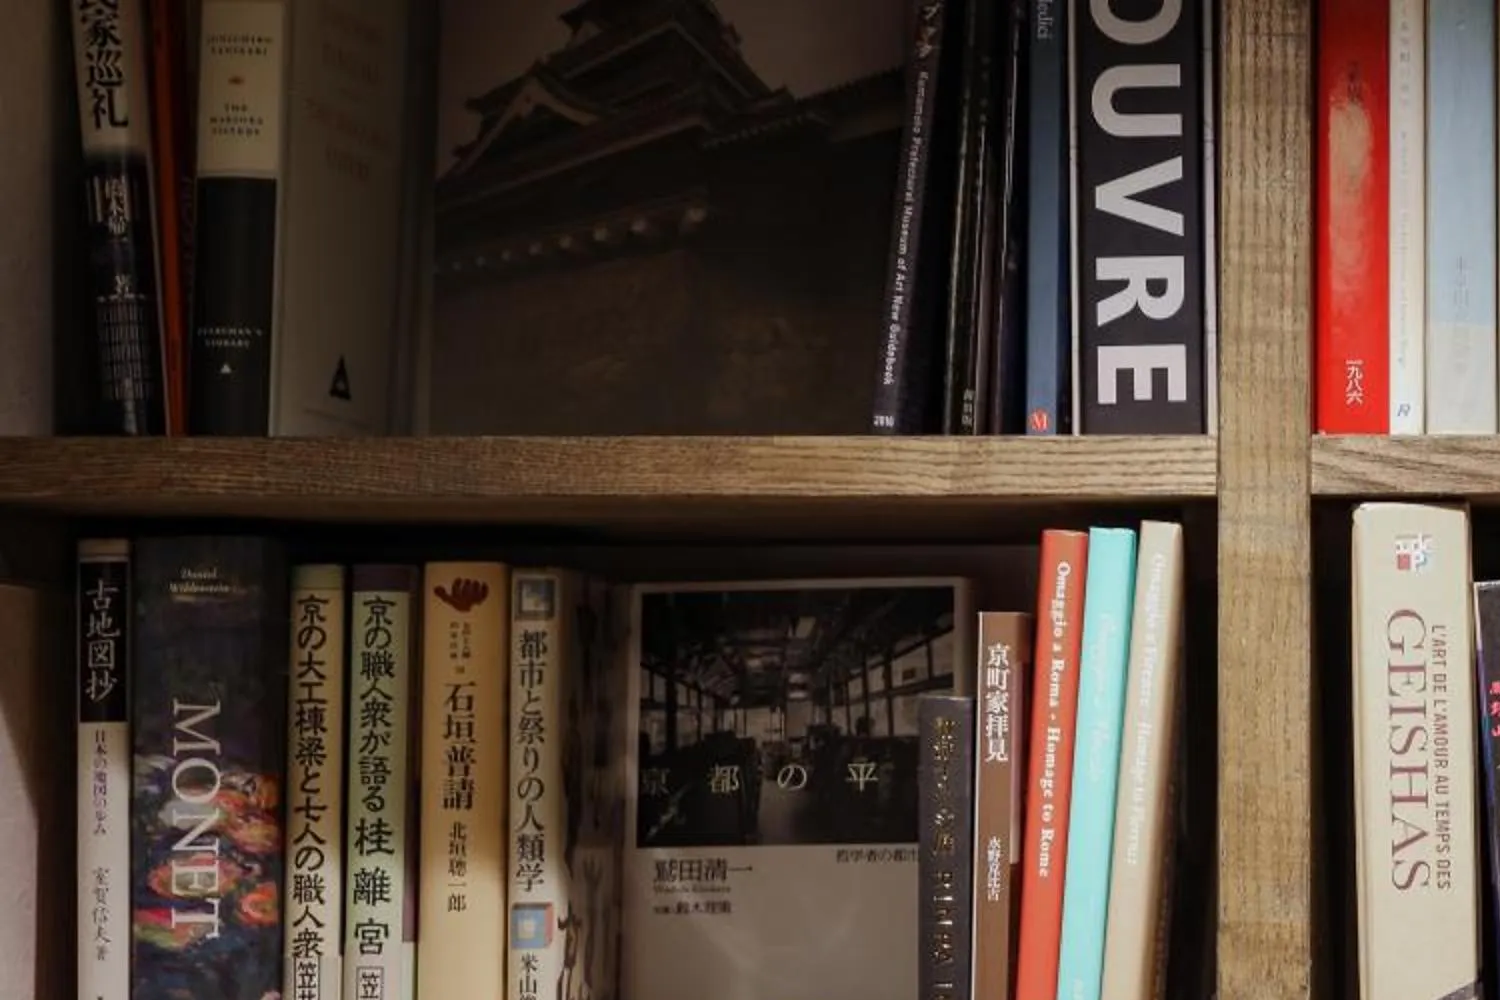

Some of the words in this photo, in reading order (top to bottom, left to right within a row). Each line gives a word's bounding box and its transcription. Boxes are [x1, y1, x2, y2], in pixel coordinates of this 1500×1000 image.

[899, 204, 915, 256] Museum
[1088, 0, 1187, 404] OUVRE
[1345, 358, 1364, 406] 一九八六
[1052, 560, 1072, 639] Omaggio
[85, 578, 121, 703] 古地図抄
[1431, 624, 1448, 671] L'ART
[1049, 657, 1065, 708] Roma
[1432, 673, 1448, 694] DE
[443, 680, 478, 811] 石垣普請
[515, 630, 547, 892] 都市と祭りの人類学
[1040, 727, 1062, 797] Homage
[1386, 607, 1431, 893] GEISHAS
[1433, 696, 1449, 776] L'AMOUR
[293, 595, 329, 957] 京の大工棟梁と七人の職人衆
[1434, 777, 1450, 797] AU
[171, 698, 222, 939] MONET
[1040, 804, 1054, 824] to
[1435, 799, 1451, 854] TEMPS
[1039, 828, 1055, 878] Rome
[1437, 855, 1452, 891] DES
